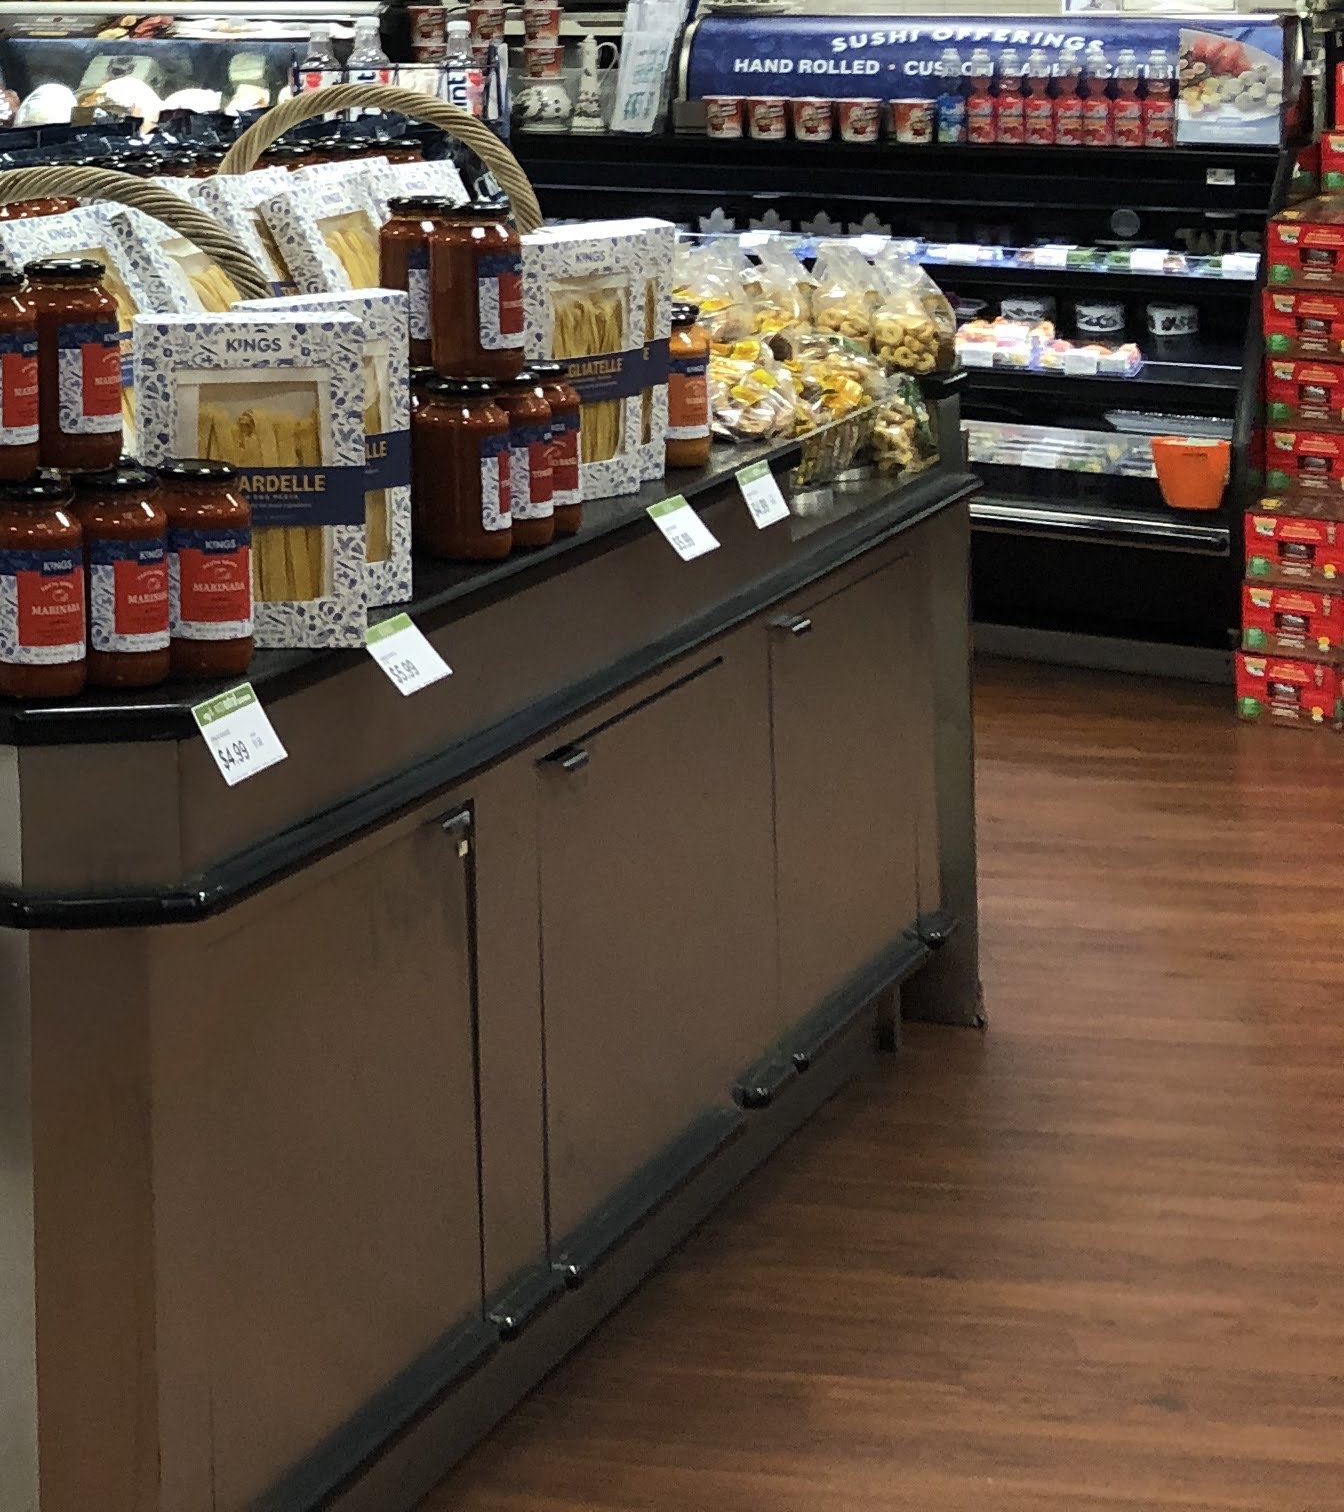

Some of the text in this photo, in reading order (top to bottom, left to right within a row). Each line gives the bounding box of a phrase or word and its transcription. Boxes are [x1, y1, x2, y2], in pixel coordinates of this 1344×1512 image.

[831, 27, 1105, 54] SUSHI OFFERINGS
[734, 59, 793, 74] HAND
[797, 59, 881, 75] ROLLED
[226, 338, 282, 354] KINGS
[238, 474, 326, 492] ARDELLE
[43, 560, 72, 571] KINGS
[32, 602, 80, 616] MARINARA
[389, 659, 420, 685] $5.99
[218, 740, 250, 772] $4.99
